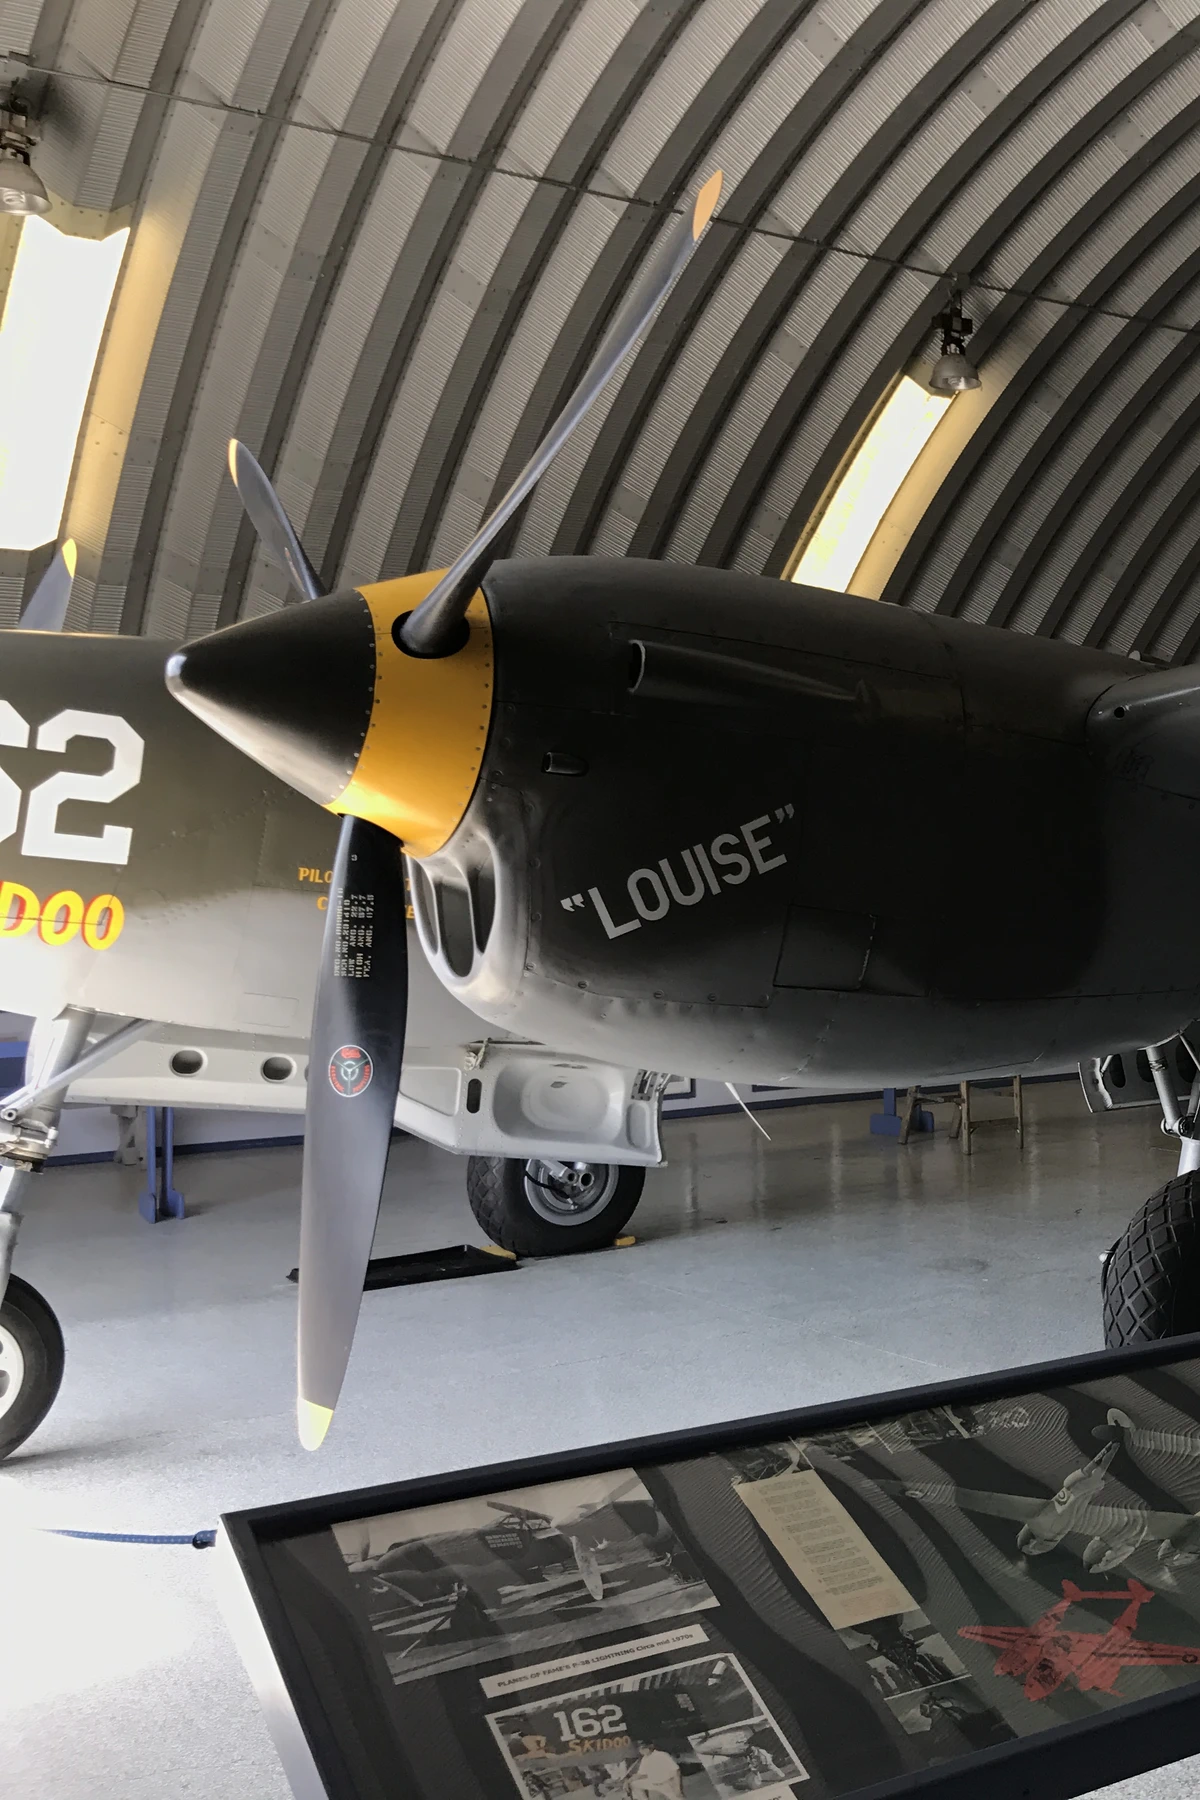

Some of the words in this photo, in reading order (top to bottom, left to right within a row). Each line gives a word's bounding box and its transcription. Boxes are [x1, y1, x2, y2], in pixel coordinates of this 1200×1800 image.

[298, 866, 334, 883] PILO
[560, 803, 795, 940] "LOUISE"
[497, 1675, 530, 1688] PLANES
[530, 1671, 542, 1680] OF
[542, 1664, 572, 1677] FAME'S
[572, 1658, 591, 1669] P-38
[592, 1647, 636, 1664] LIGHTNING
[636, 1642, 655, 1653] Circa
[656, 1637, 671, 1647] mid
[671, 1632, 694, 1644] 1970s
[553, 1704, 628, 1742] 162
[568, 1735, 632, 1756] SKIDOO
